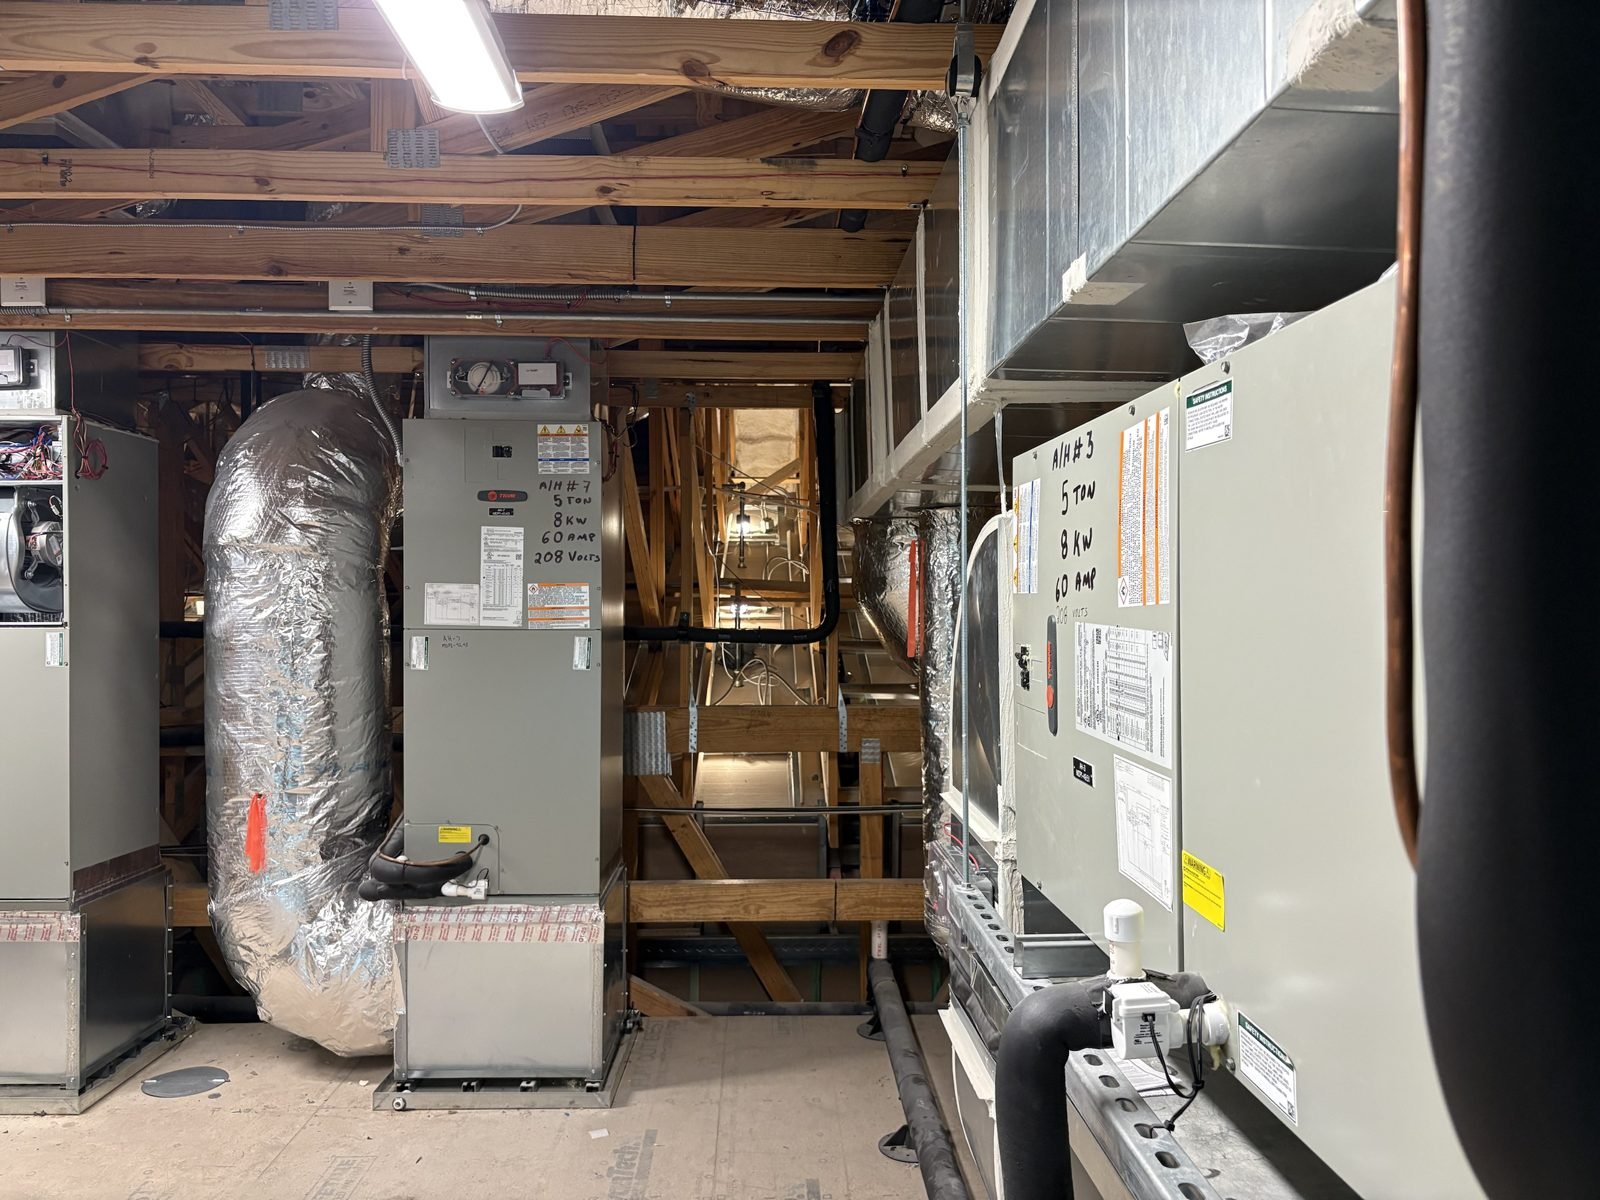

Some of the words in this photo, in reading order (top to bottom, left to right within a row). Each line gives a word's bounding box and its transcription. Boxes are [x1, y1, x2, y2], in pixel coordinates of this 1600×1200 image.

[1052, 441, 1070, 471] A/H
[539, 480, 562, 492] A/H
[553, 494, 563, 507] 5
[566, 496, 592, 504] TON
[1062, 479, 1069, 515] 5
[1073, 480, 1095, 505] TON
[553, 511, 563, 527] 8
[566, 515, 587, 525] KW
[541, 530, 564, 544] 60
[567, 532, 596, 542] AMP
[1061, 529, 1068, 560] 8
[1073, 527, 1092, 557] KW
[534, 550, 564, 564] 208
[1056, 574, 1068, 603] 60
[1075, 567, 1096, 592] AMP
